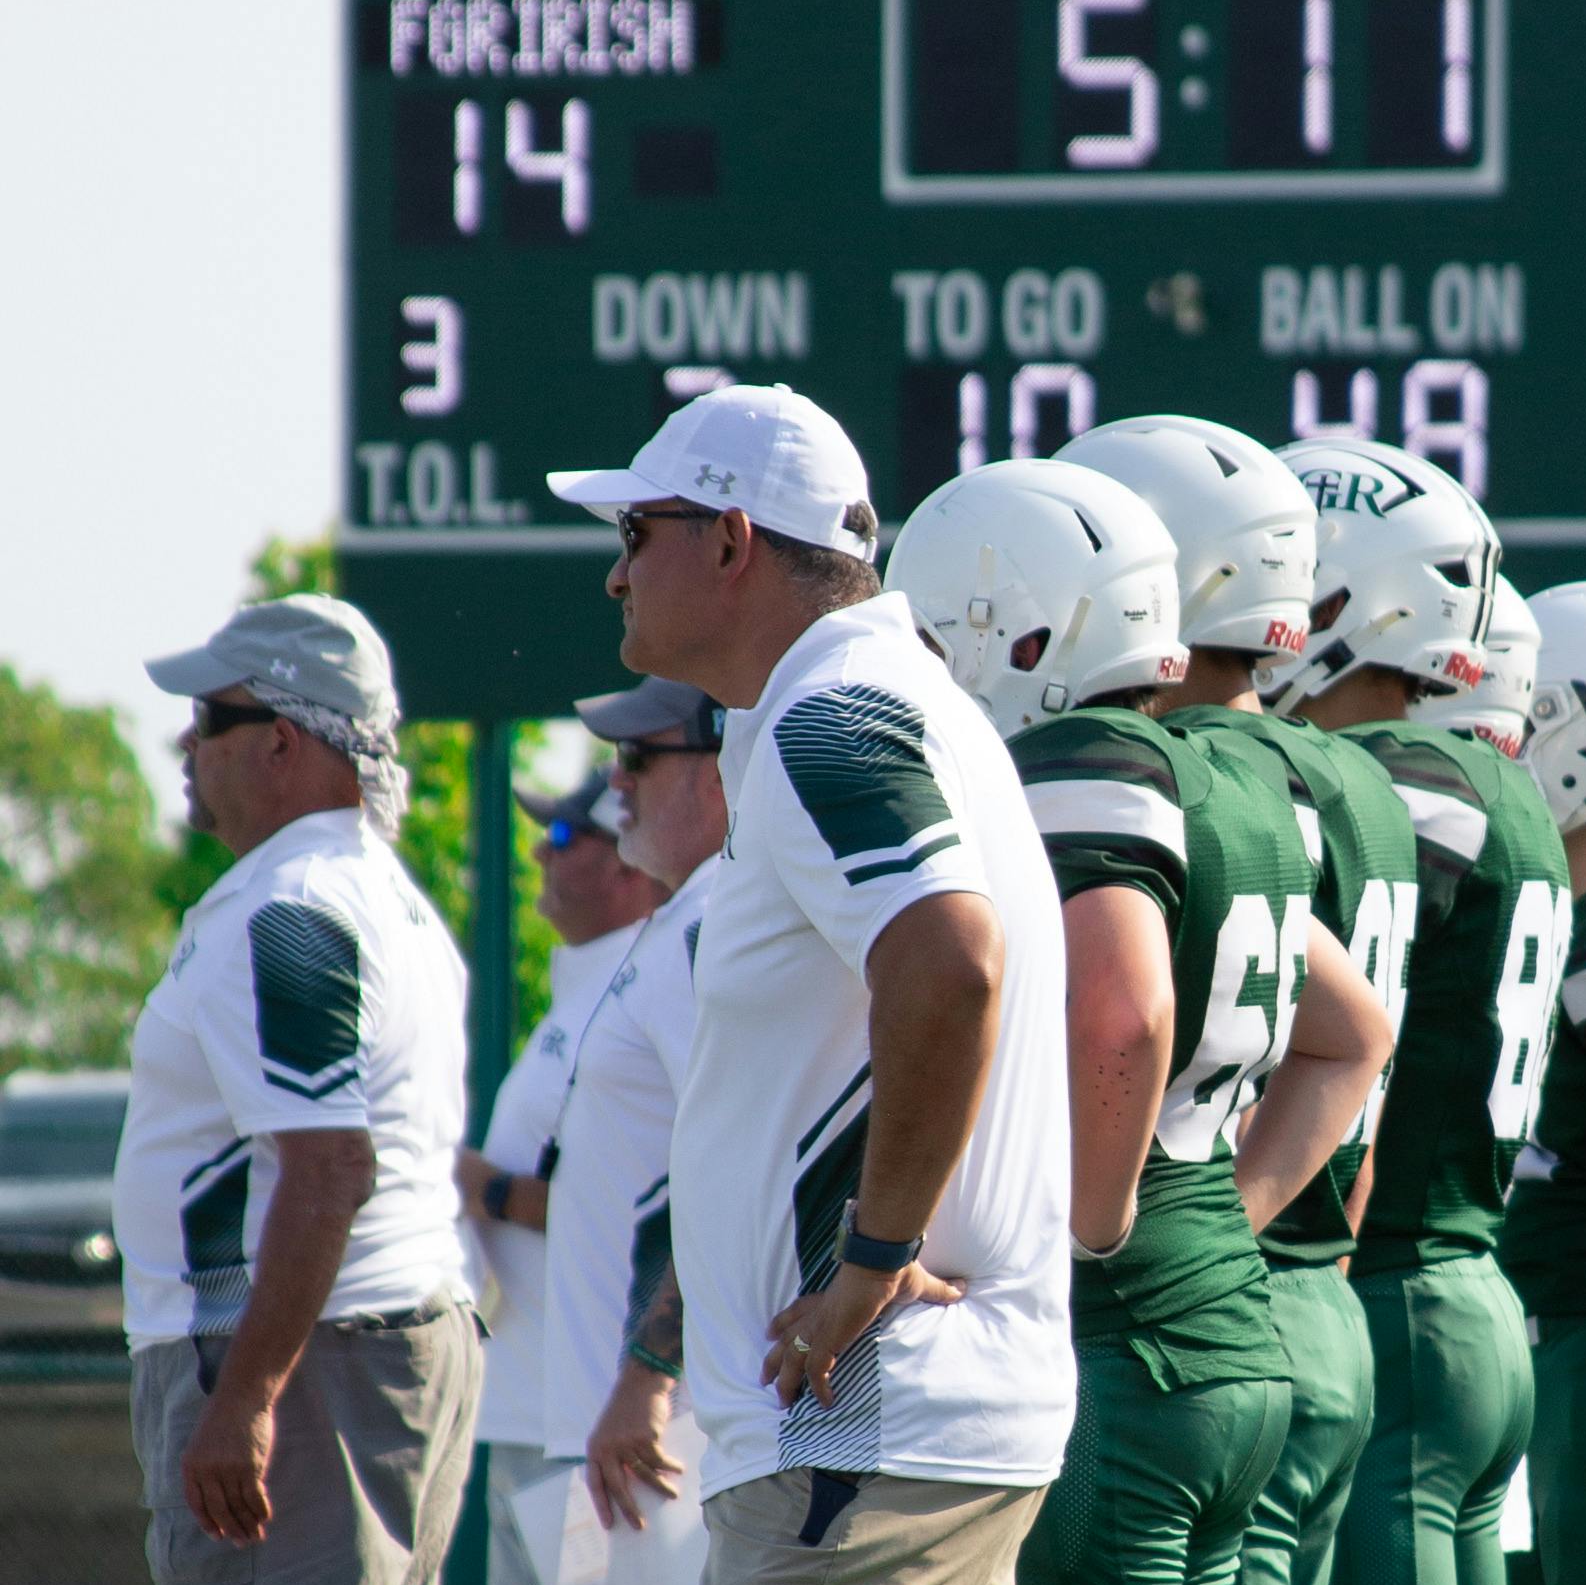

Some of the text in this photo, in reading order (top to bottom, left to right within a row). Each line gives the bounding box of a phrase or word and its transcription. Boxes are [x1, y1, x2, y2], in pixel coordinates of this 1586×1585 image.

[453, 98, 591, 236] 14
[592, 271, 810, 362] DOWN
[893, 268, 1104, 360] TO GO
[1259, 262, 1525, 354] BALL ON
[400, 294, 463, 416] 3
[357, 442, 530, 527] T.O.L.
[1487, 880, 1572, 1144] 8
